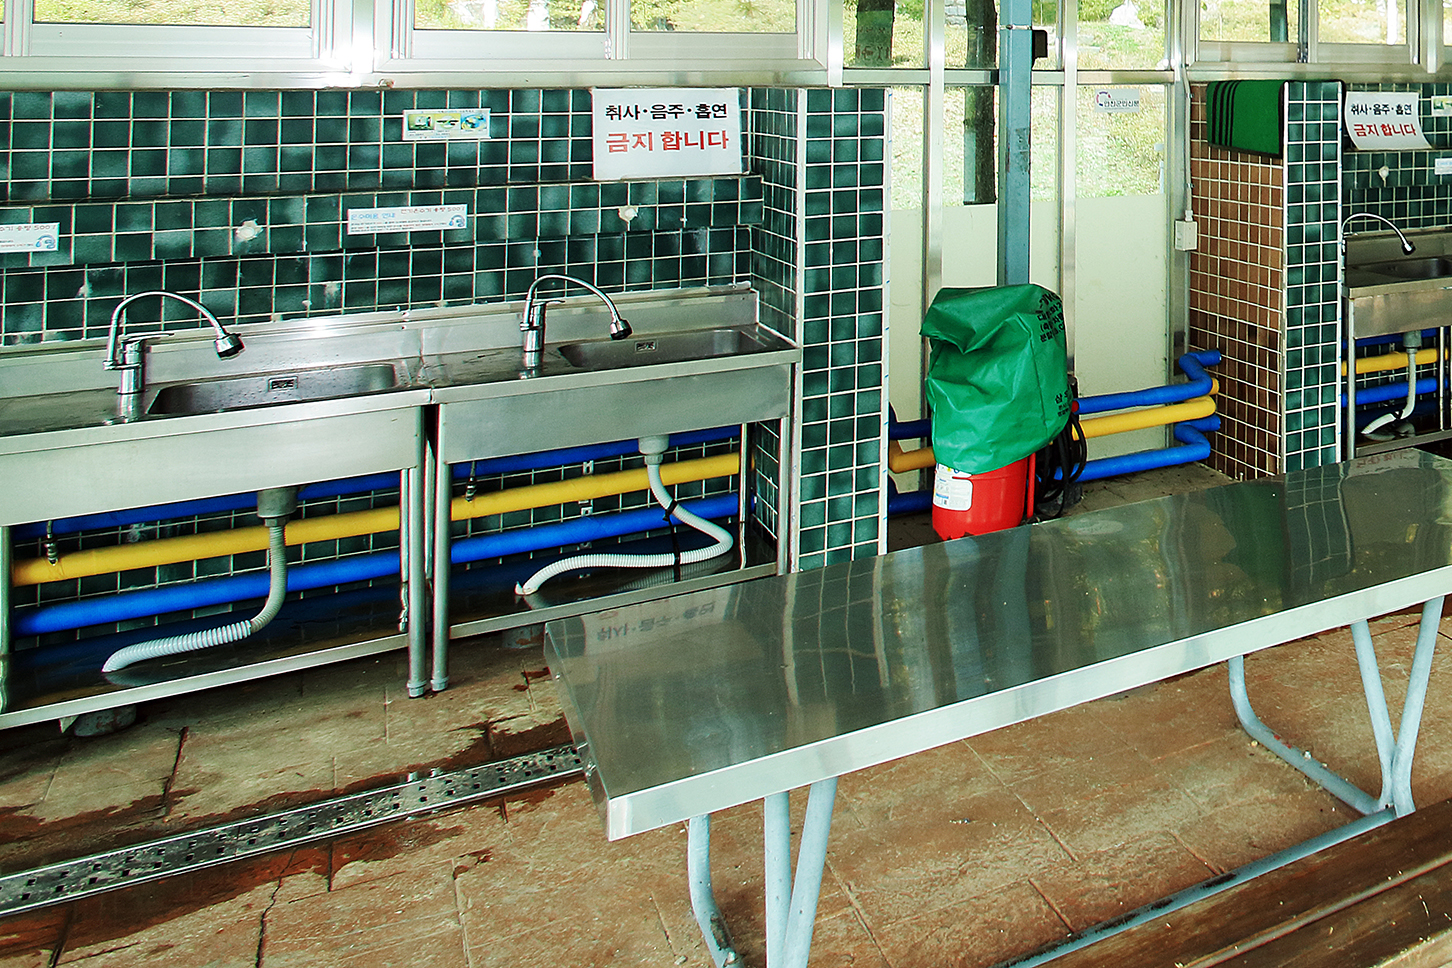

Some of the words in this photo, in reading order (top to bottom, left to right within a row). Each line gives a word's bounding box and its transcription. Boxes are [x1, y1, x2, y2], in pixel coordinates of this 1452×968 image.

[605, 103, 728, 120] 취사·음주·흡연
[1351, 104, 1412, 116] 취사·음주·흡연
[1353, 124, 1379, 137] 금지
[1380, 123, 1417, 137] 합니다
[606, 131, 653, 153] 금지
[660, 130, 729, 151] 합니다
